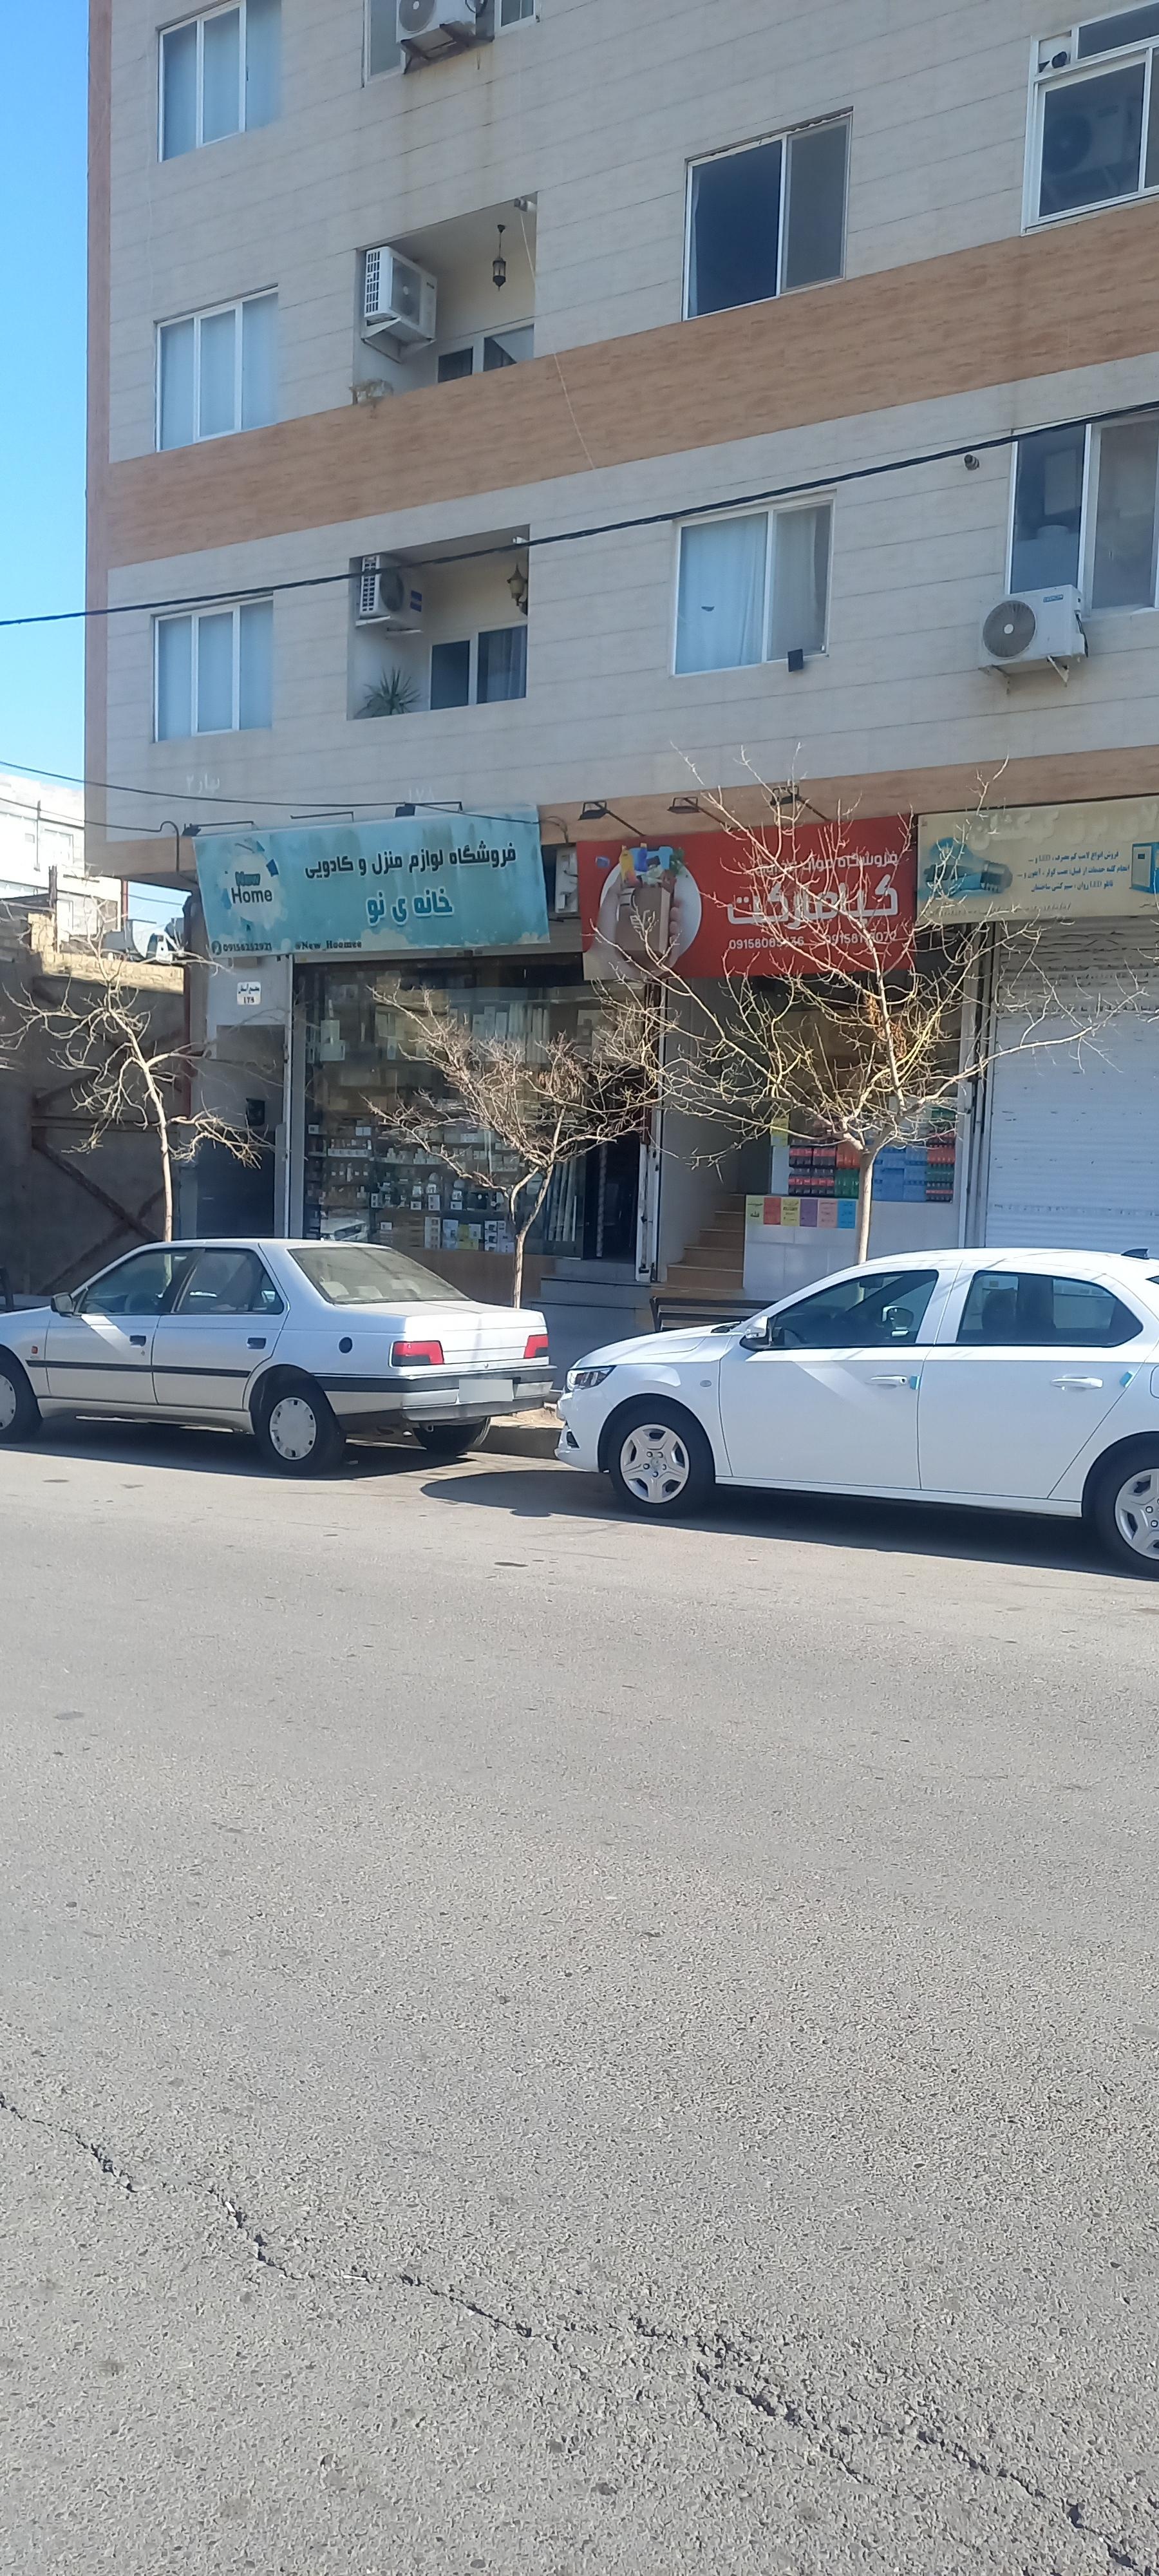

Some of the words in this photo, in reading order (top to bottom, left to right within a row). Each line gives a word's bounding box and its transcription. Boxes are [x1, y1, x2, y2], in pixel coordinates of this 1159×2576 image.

[372, 851, 402, 875] منزل
[408, 848, 444, 873] لوازم
[449, 840, 516, 868] فروشگاه
[837, 850, 898, 869] فروشگاه
[305, 855, 353, 879] کادویی
[358, 857, 366, 876] و
[231, 884, 273, 904] Home
[413, 887, 453, 917] خانه
[367, 891, 385, 925] نو
[391, 897, 407, 923] ی
